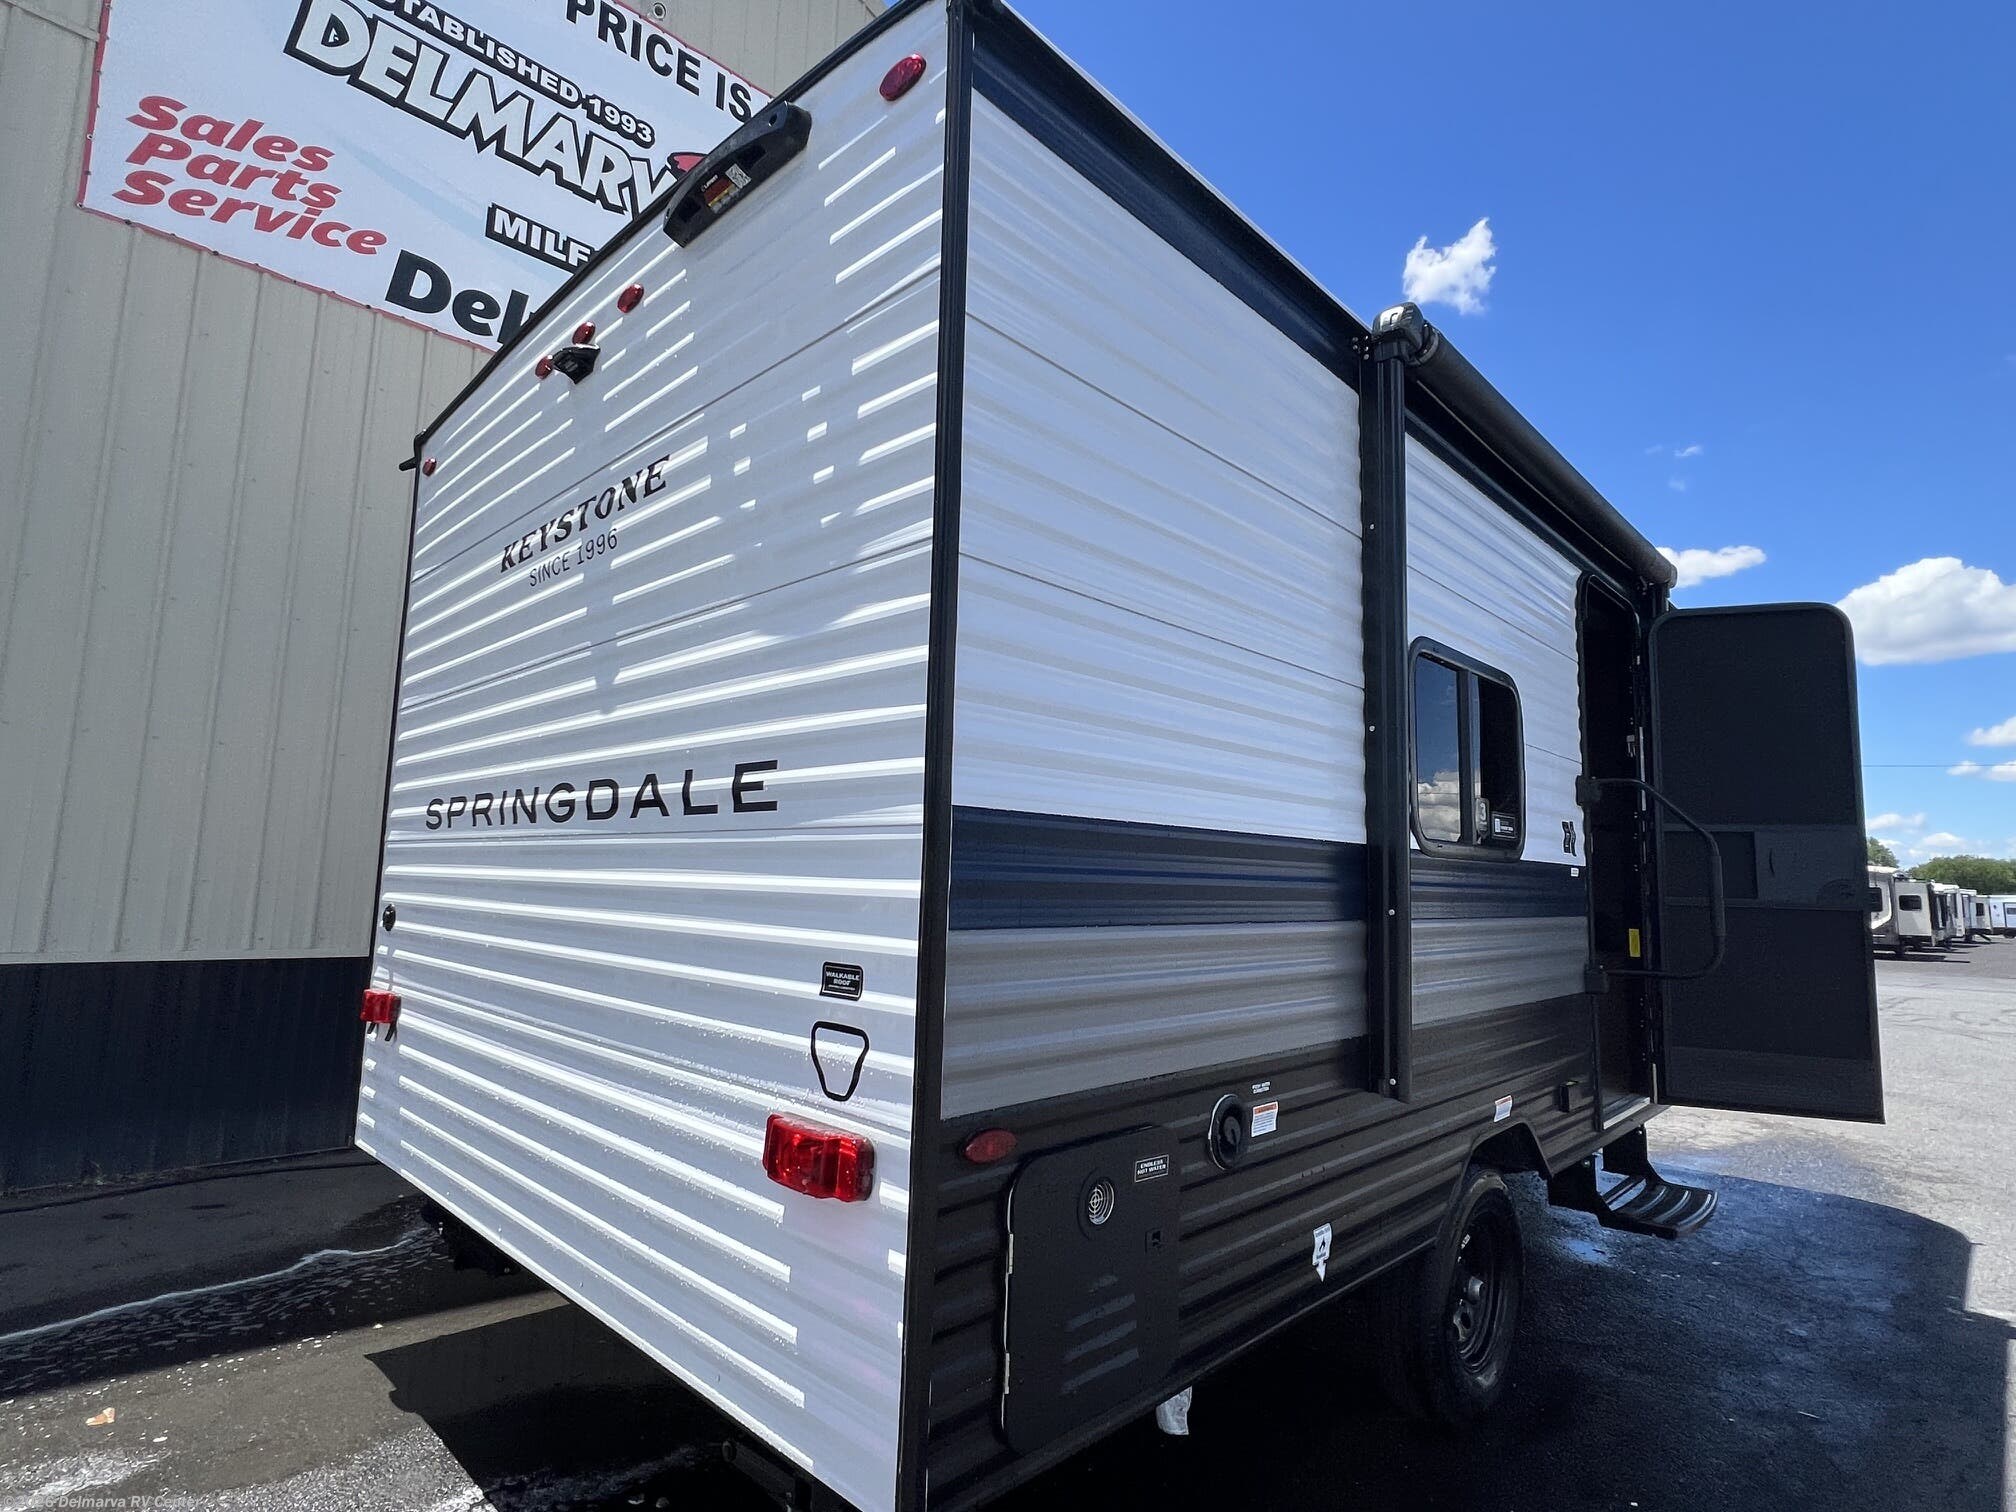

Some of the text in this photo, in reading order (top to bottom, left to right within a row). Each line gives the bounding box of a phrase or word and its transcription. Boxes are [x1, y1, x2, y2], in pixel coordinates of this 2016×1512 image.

[386, 0, 653, 143] TABLISHED 1993
[566, 0, 752, 123] PRICE IS
[126, 96, 335, 171] Sales
[286, 0, 678, 217] DELMARV
[126, 133, 342, 209] Parts
[112, 170, 387, 255] Service
[492, 206, 592, 268] MILF
[385, 249, 532, 343] Del
[500, 454, 670, 573] KEYSTONE
[529, 528, 618, 587] SINCE 1996
[425, 760, 778, 830] SPRINGDALE
[825, 971, 860, 981] WALKABLE
[833, 978, 851, 986] ROOF
